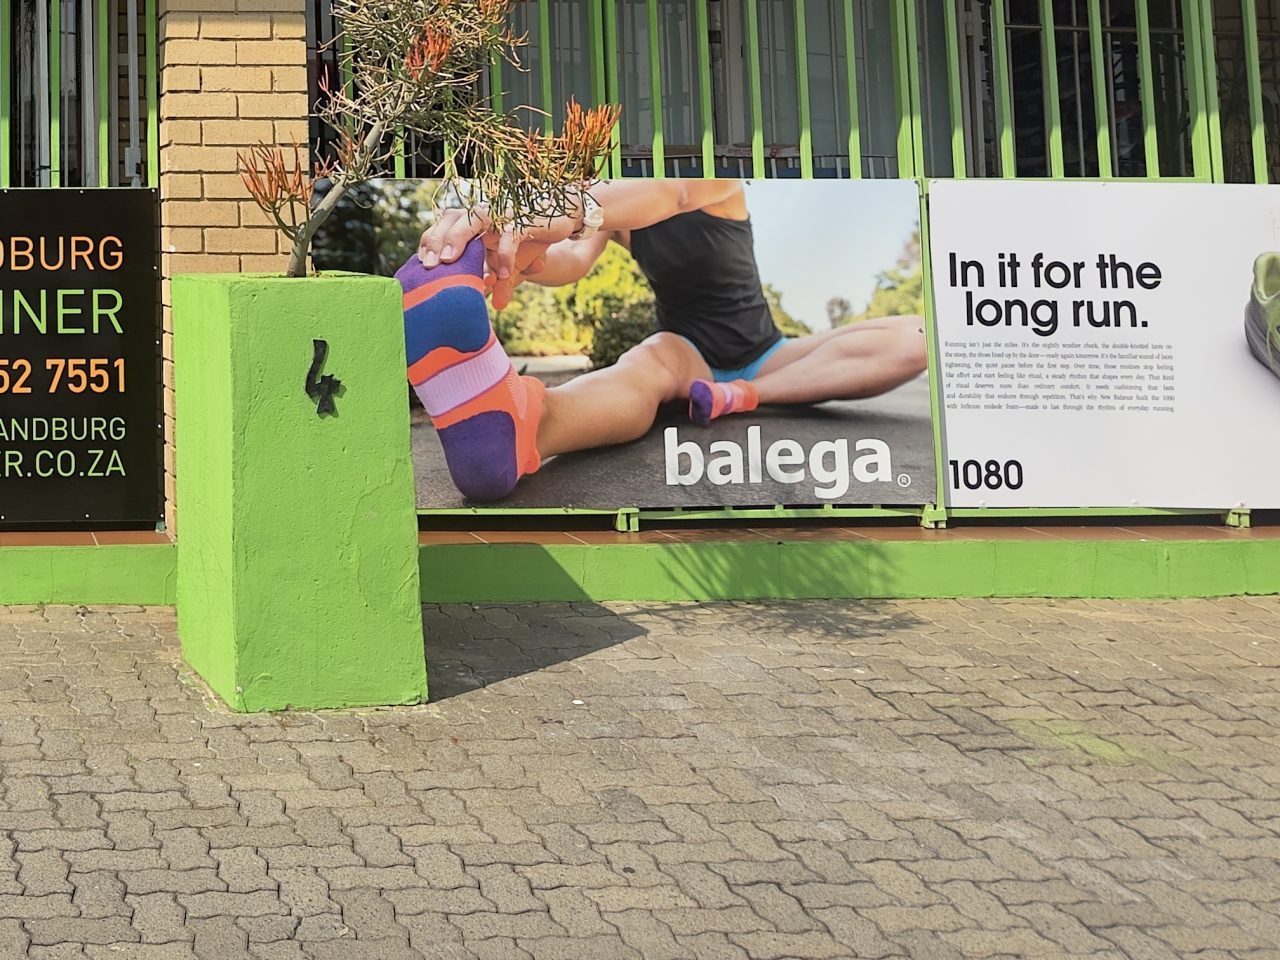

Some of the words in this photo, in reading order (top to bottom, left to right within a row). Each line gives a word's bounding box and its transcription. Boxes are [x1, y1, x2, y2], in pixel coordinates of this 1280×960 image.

[949, 252, 984, 287] In
[998, 253, 1020, 288] it
[1031, 252, 1085, 289] for
[1096, 253, 1162, 290] the
[965, 291, 1059, 337] long
[1072, 299, 1148, 328] run.
[45, 358, 126, 393] 7551
[664, 425, 892, 499] balega
[949, 459, 1023, 490] 1080
